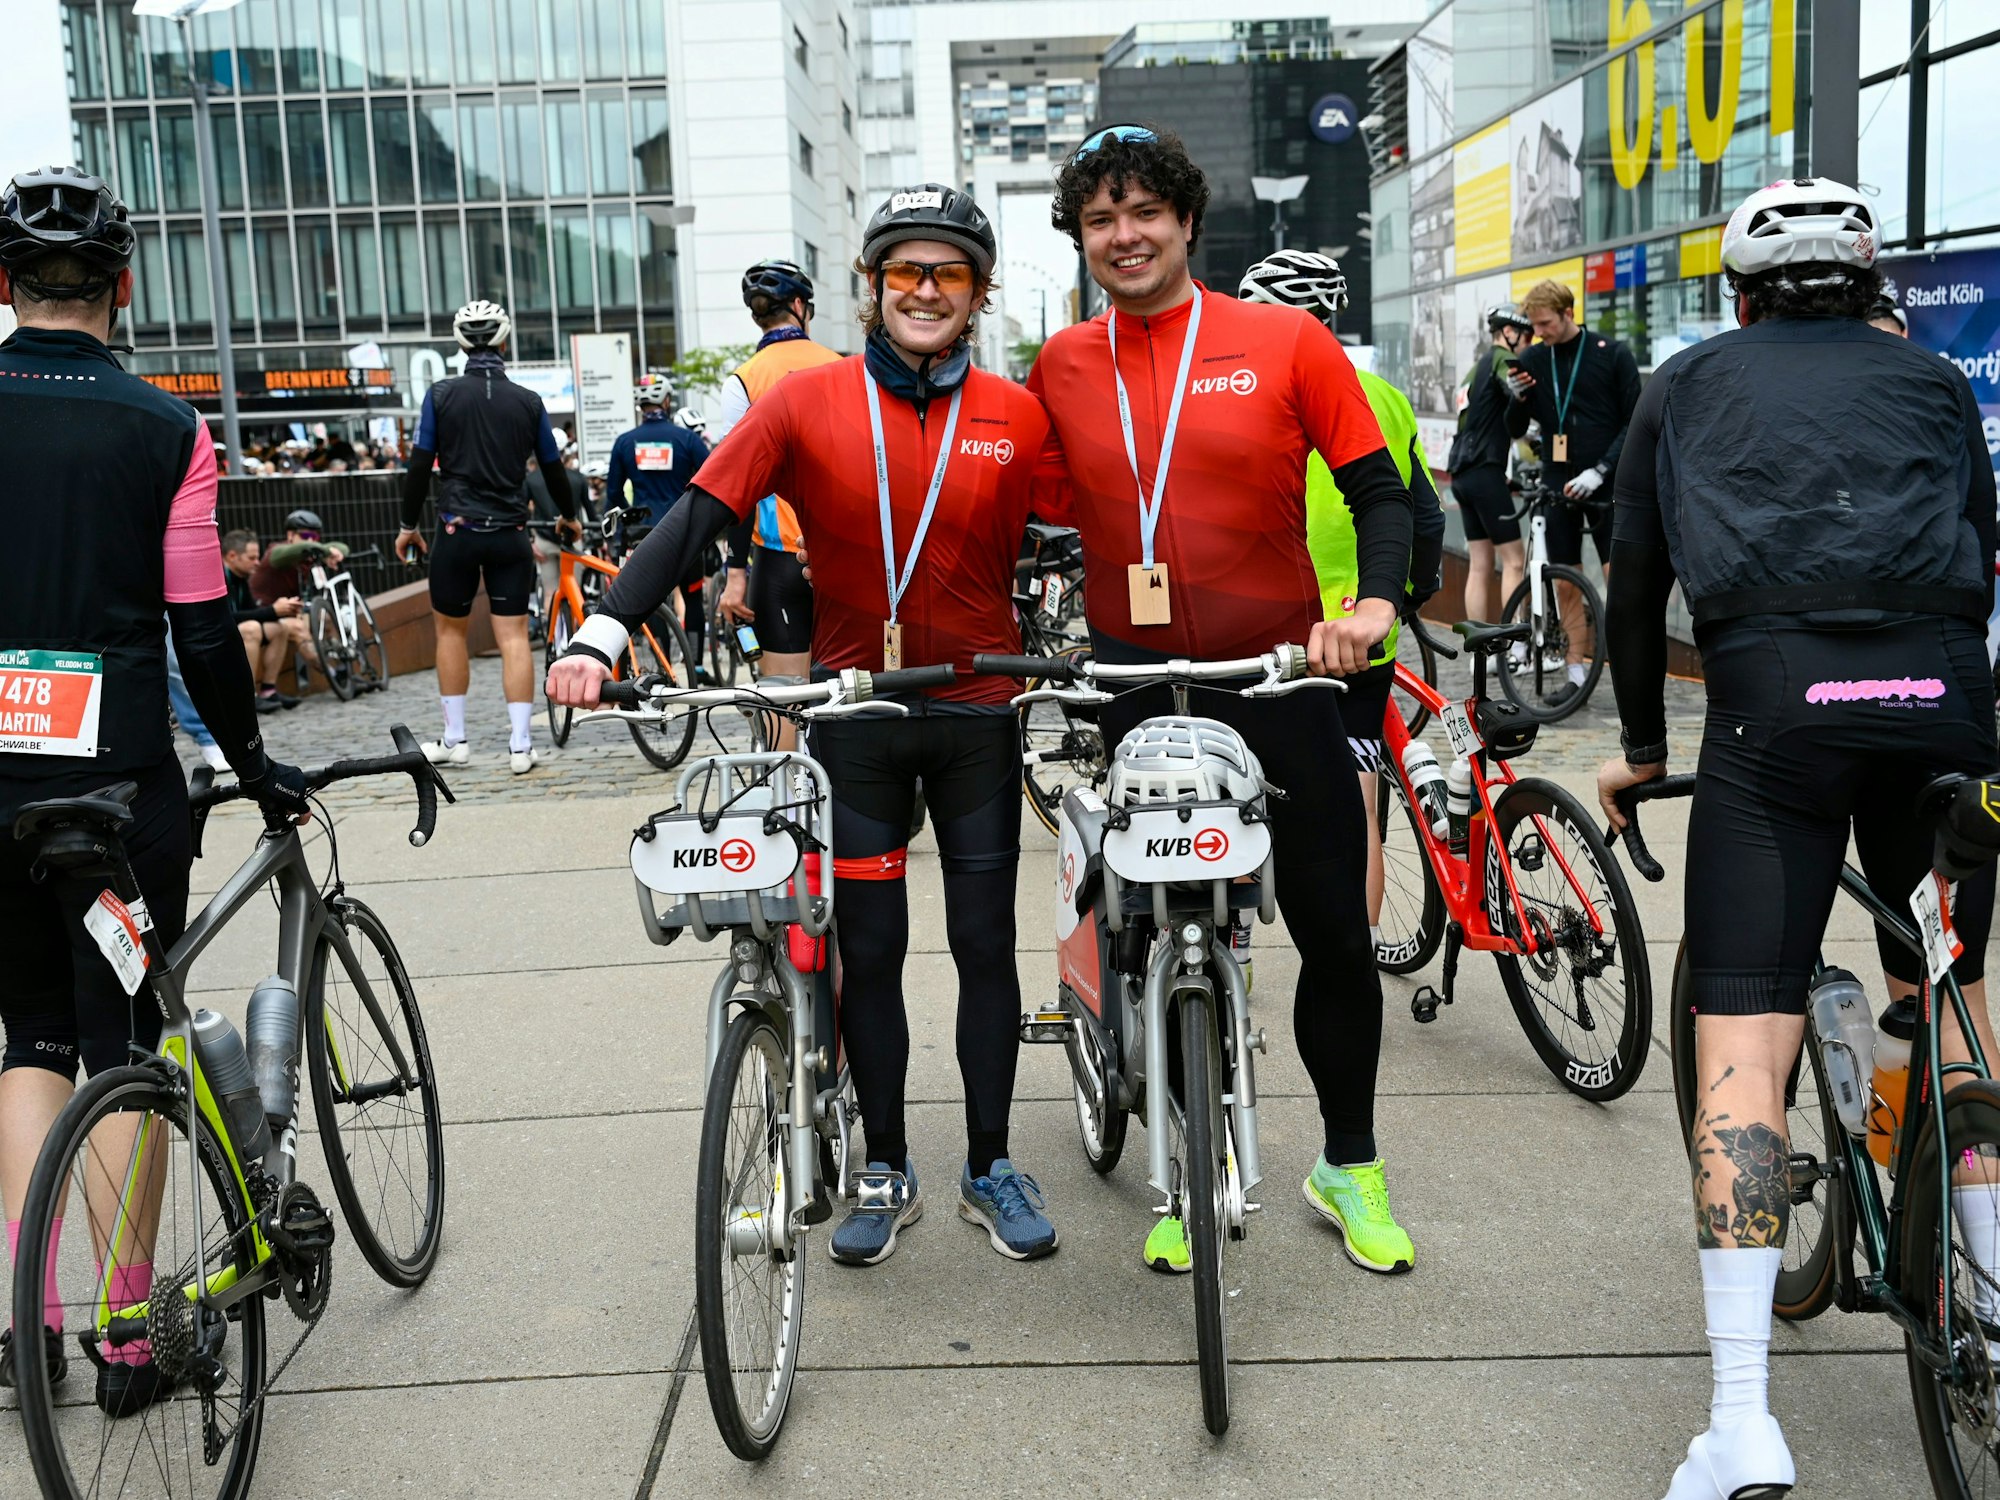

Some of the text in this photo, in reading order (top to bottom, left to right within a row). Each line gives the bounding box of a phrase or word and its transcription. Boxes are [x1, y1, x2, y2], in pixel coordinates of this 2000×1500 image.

[1319, 108, 1350, 127] EA
[897, 194, 935, 206] 9127
[1258, 269, 1279, 277] GIRO
[1906, 283, 1984, 307] Stadt Köln
[265, 369, 350, 390] BRENNWERK
[1191, 376, 1229, 395] KVB
[960, 439, 993, 457] KVB
[1047, 582, 1058, 609] 6614
[55, 659, 94, 670] VELODOM 120
[1879, 700, 1940, 710] Racing Team
[0, 711, 52, 734] ARTIN
[1457, 716, 1471, 737] 4035
[1145, 837, 1192, 858] KVB
[673, 848, 718, 869] KVB
[113, 924, 133, 957] 7478
[35, 1040, 74, 1056] GORE
